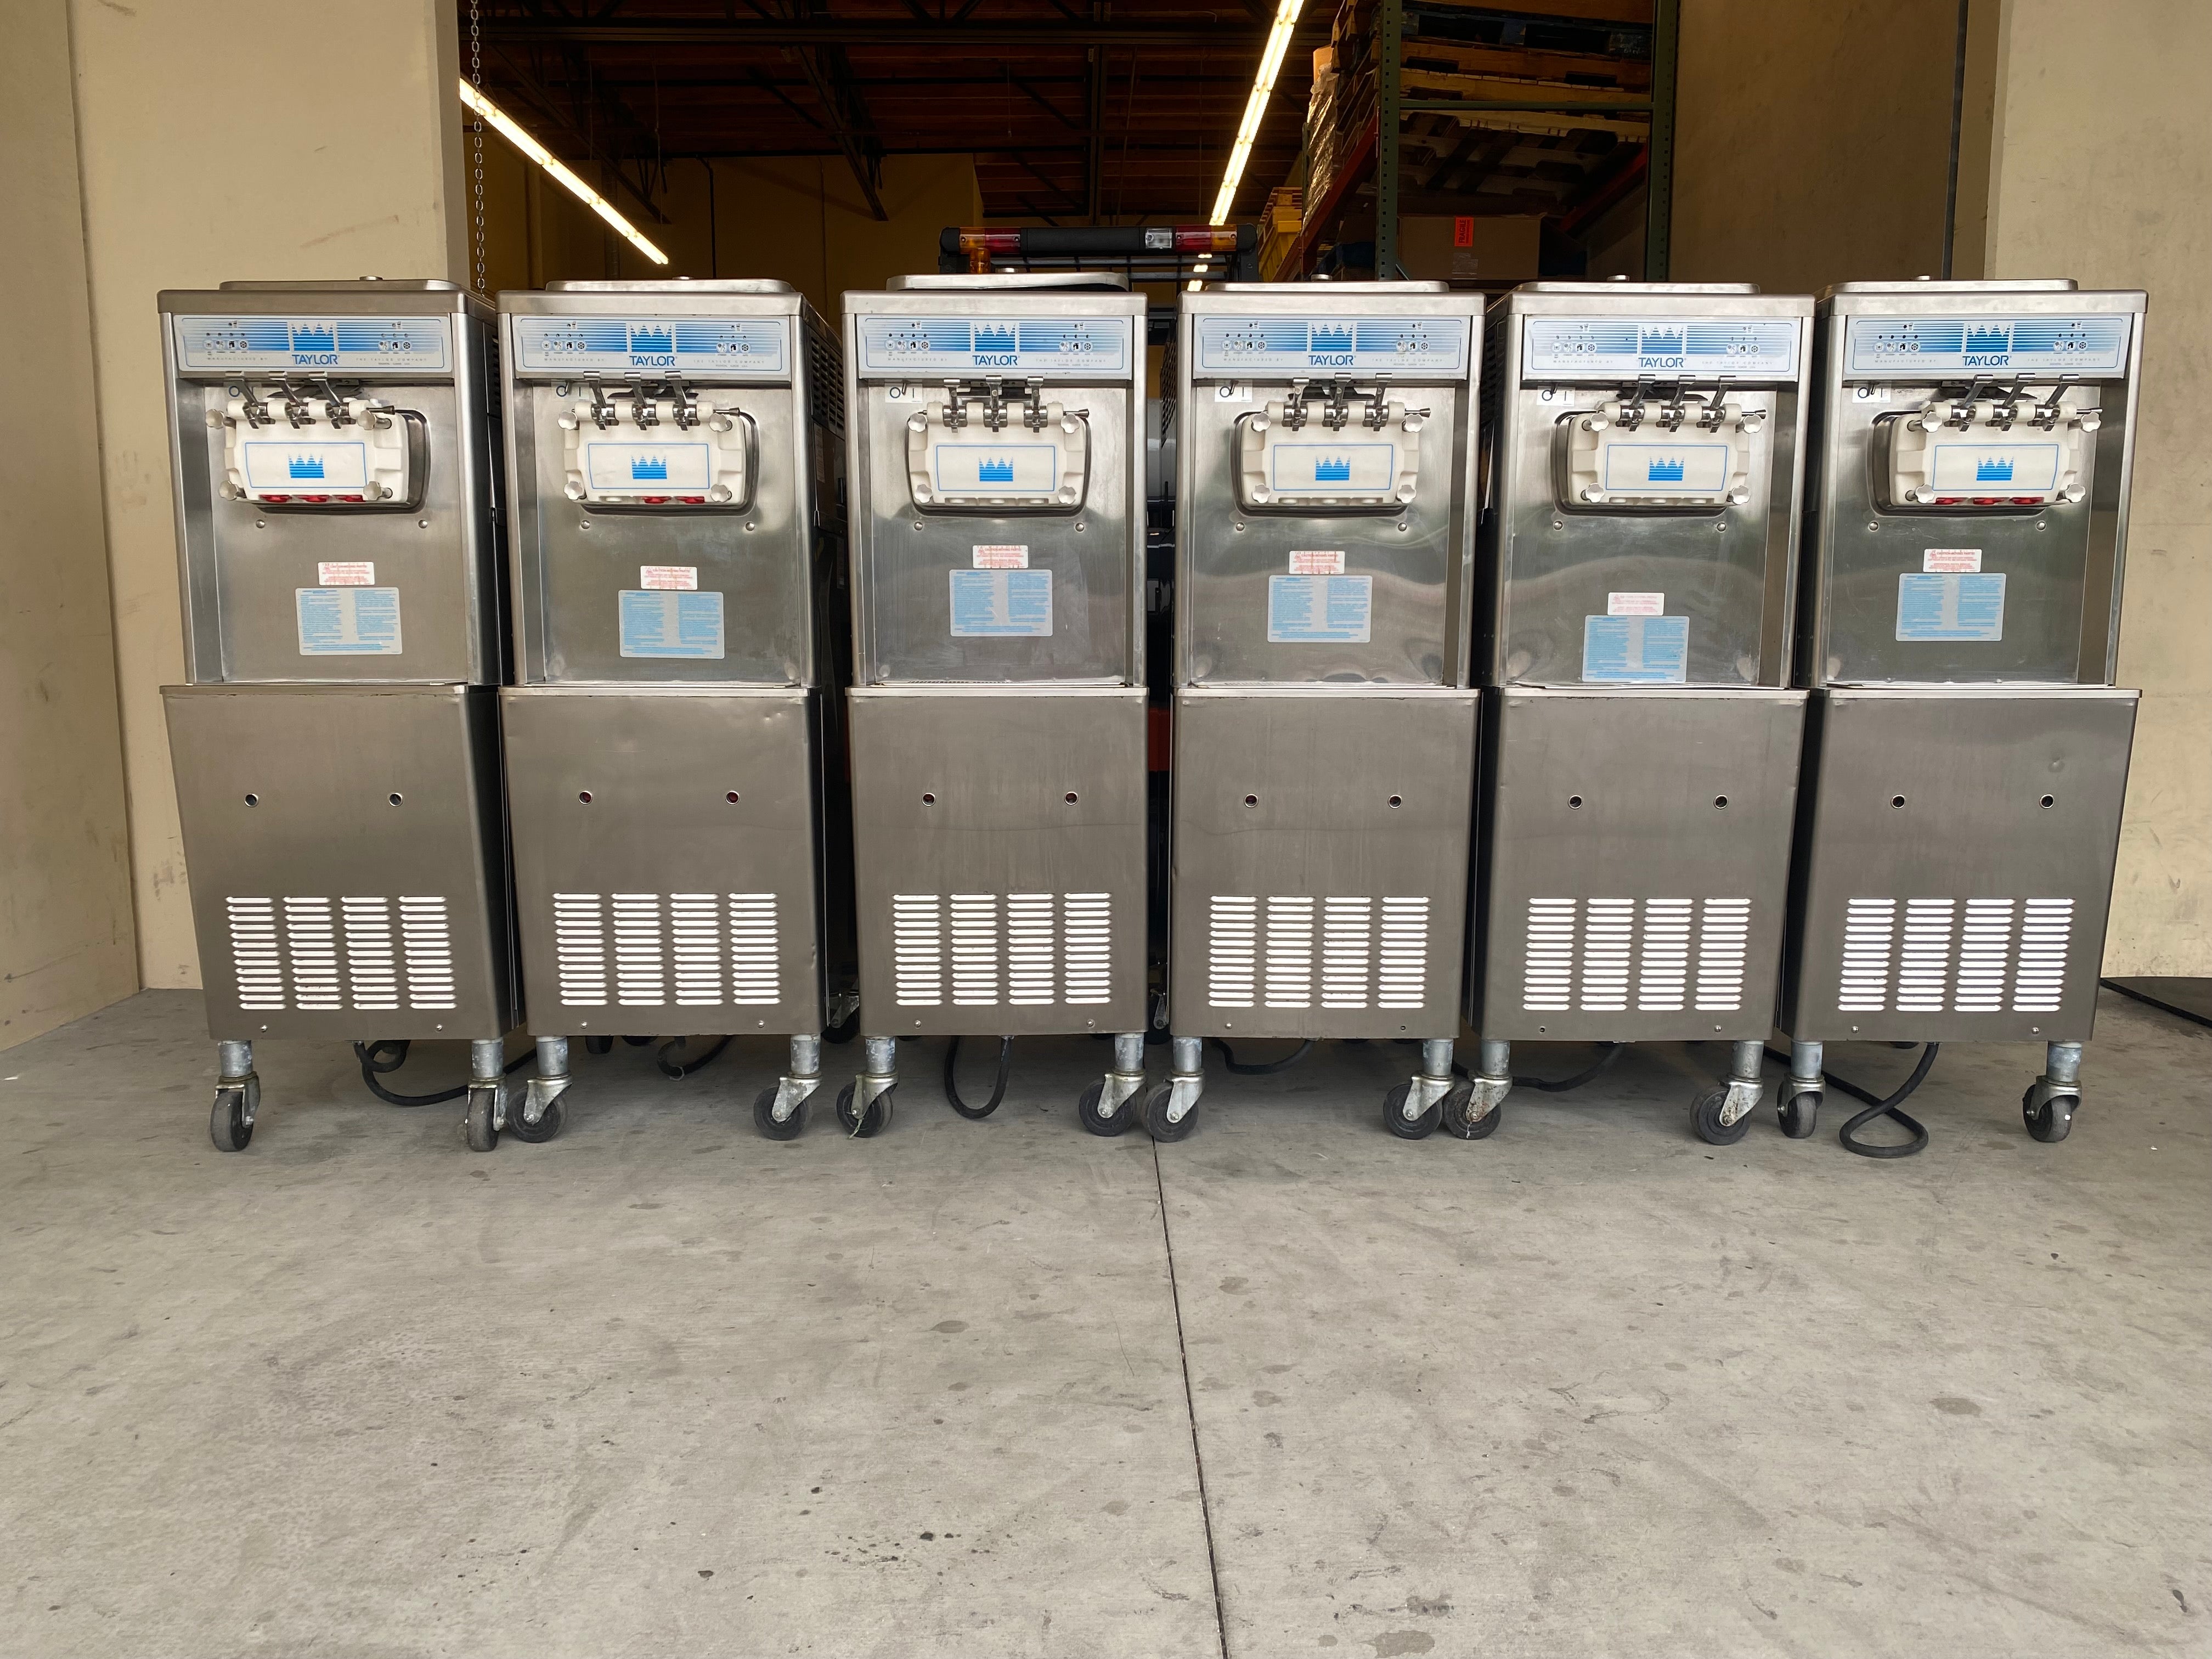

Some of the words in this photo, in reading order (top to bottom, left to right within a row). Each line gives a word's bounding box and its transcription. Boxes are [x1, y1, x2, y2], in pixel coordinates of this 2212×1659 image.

[291, 354, 338, 365] TAYLOR
[629, 356, 675, 366] TAYLOR
[972, 355, 1018, 365] TAYLOR
[1308, 355, 1353, 365] TAYLOR
[1638, 357, 1684, 368] TAYLOR
[1962, 355, 2009, 366] TAYLOR
